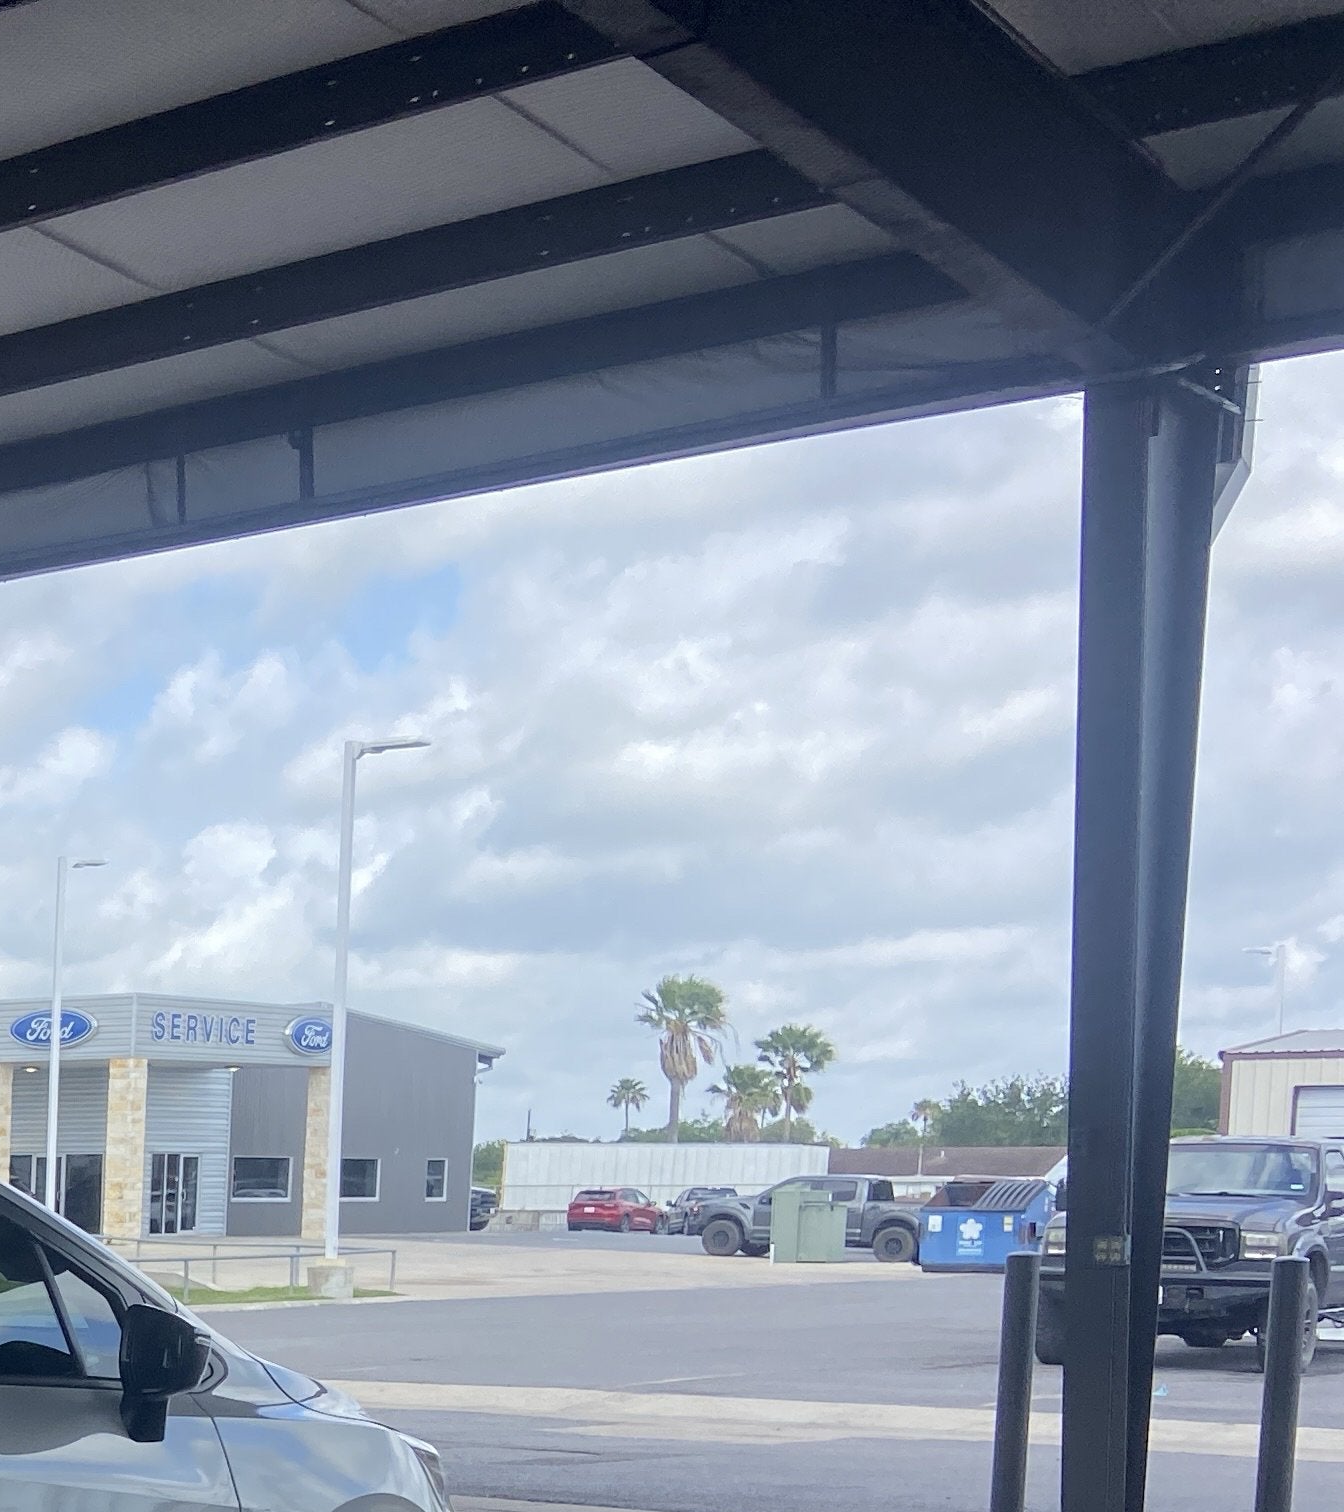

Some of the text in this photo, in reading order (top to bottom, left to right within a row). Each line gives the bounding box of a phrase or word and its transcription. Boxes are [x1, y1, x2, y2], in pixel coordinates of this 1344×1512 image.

[25, 1016, 75, 1042] Fod
[153, 1012, 257, 1046] SERVICE
[300, 1024, 330, 1049] Ford
